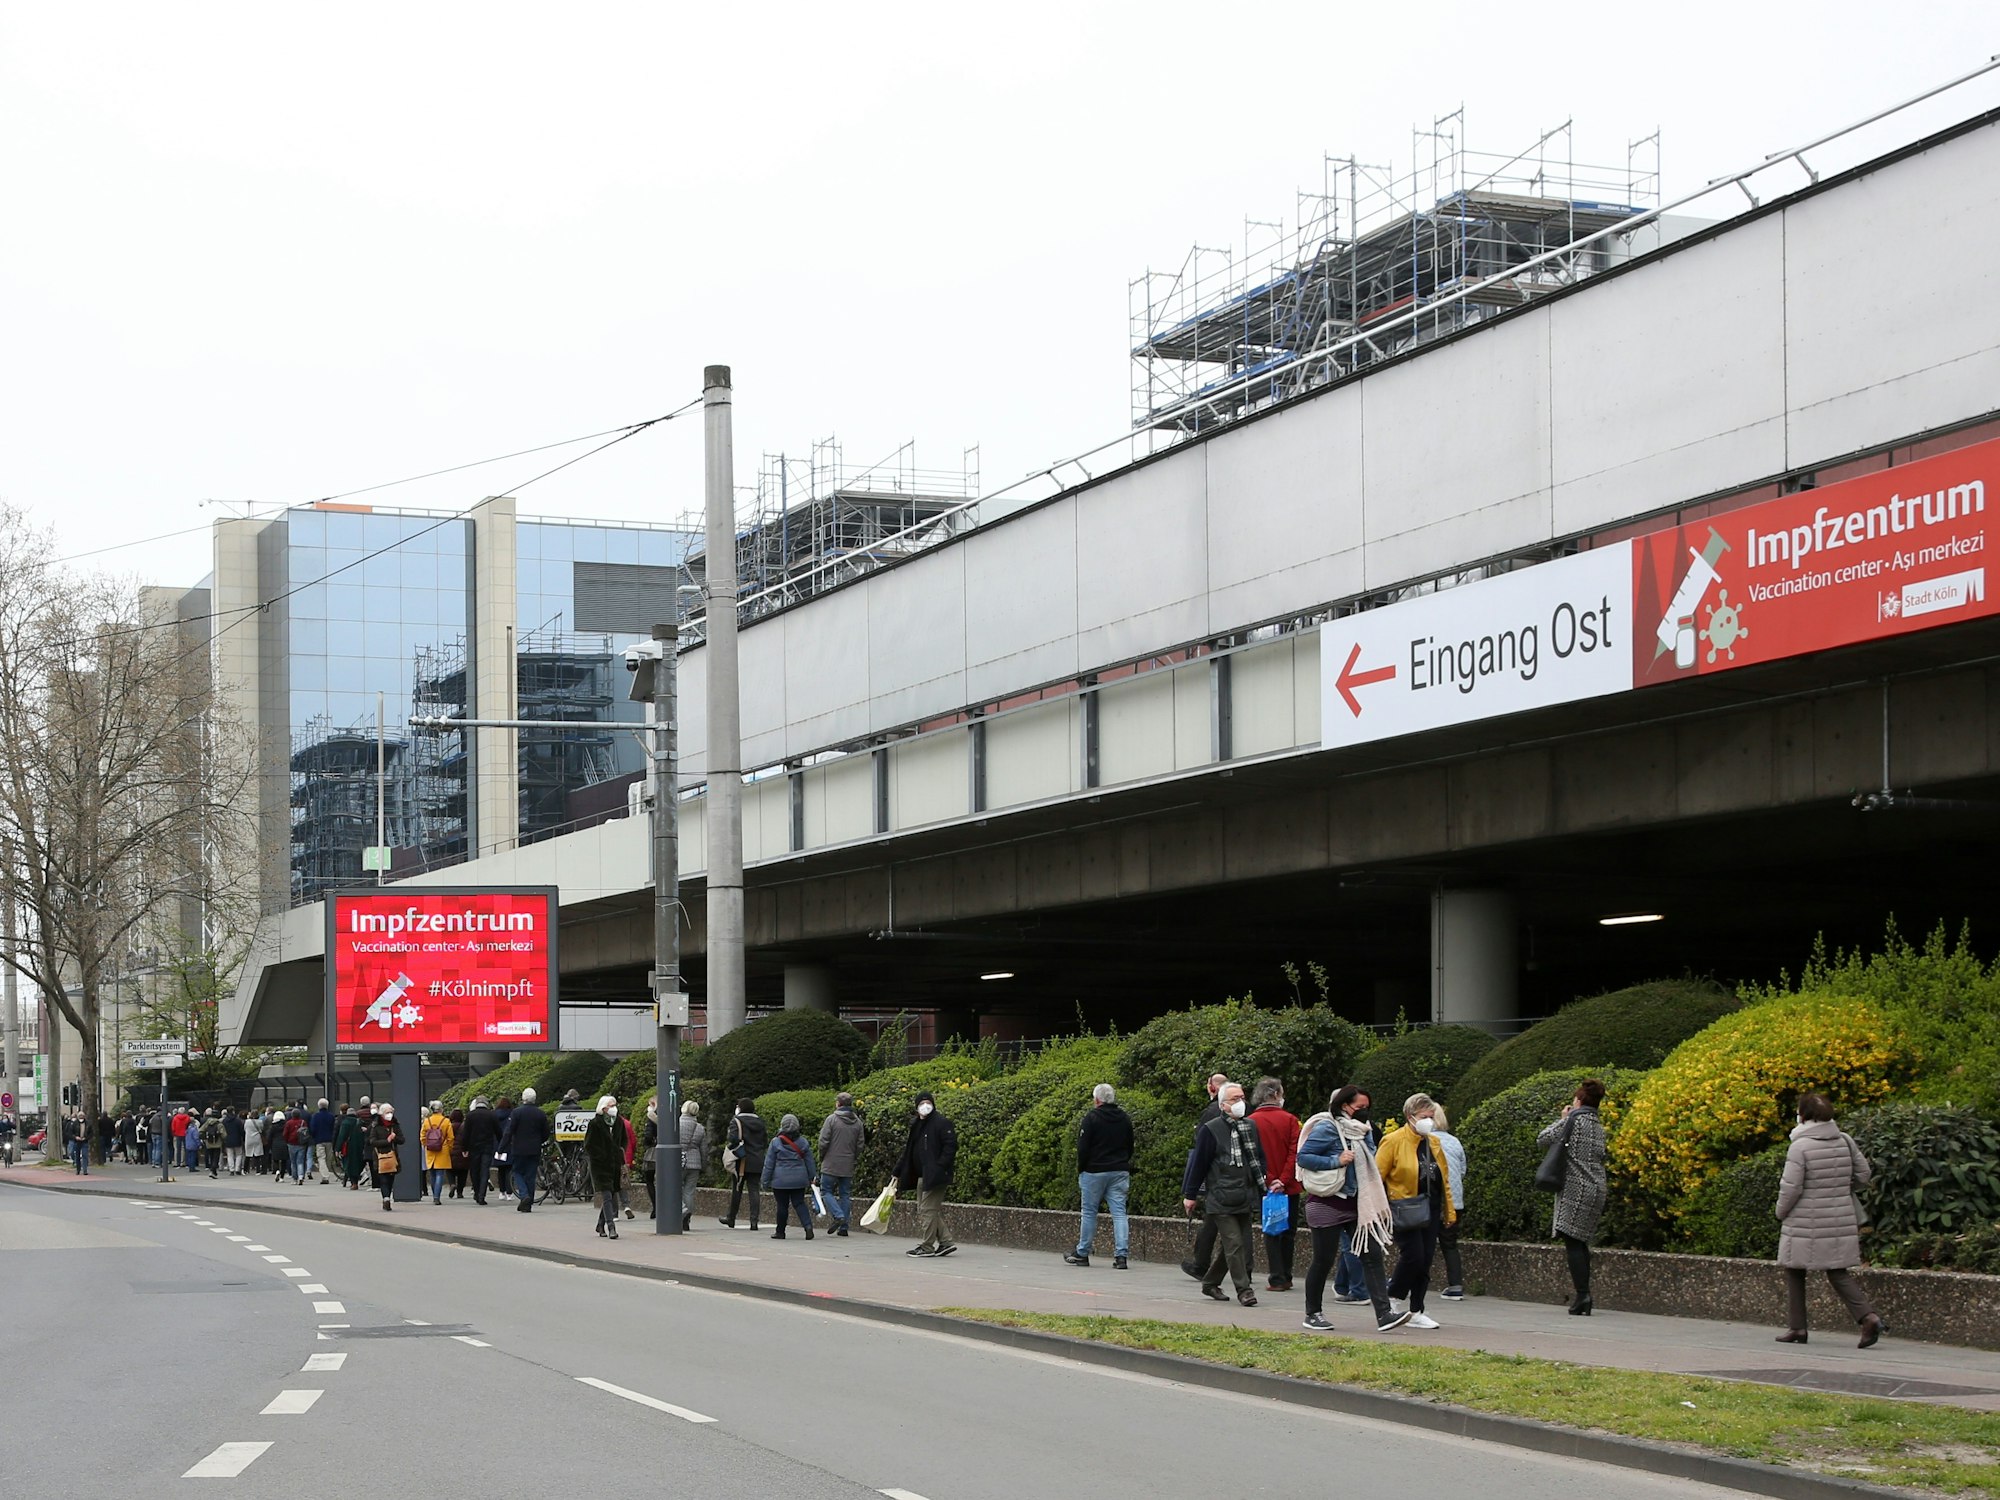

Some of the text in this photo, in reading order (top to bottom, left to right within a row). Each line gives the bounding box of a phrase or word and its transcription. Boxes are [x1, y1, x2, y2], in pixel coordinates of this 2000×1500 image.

[1748, 479, 1985, 569] Impfzentrum
[1748, 530, 1984, 603] Vaccination center Aşı merkezi
[1905, 585, 1958, 608] Stadt Köln
[1411, 595, 1612, 694] Eingang Ost
[351, 907, 534, 938] Impfzentrum
[352, 939, 534, 954] Vaccination center Aşı merkezi
[428, 979, 534, 1001] #Kölnimpft
[128, 1042, 180, 1051] Parkleitsystem
[563, 1120, 587, 1132] Rie
